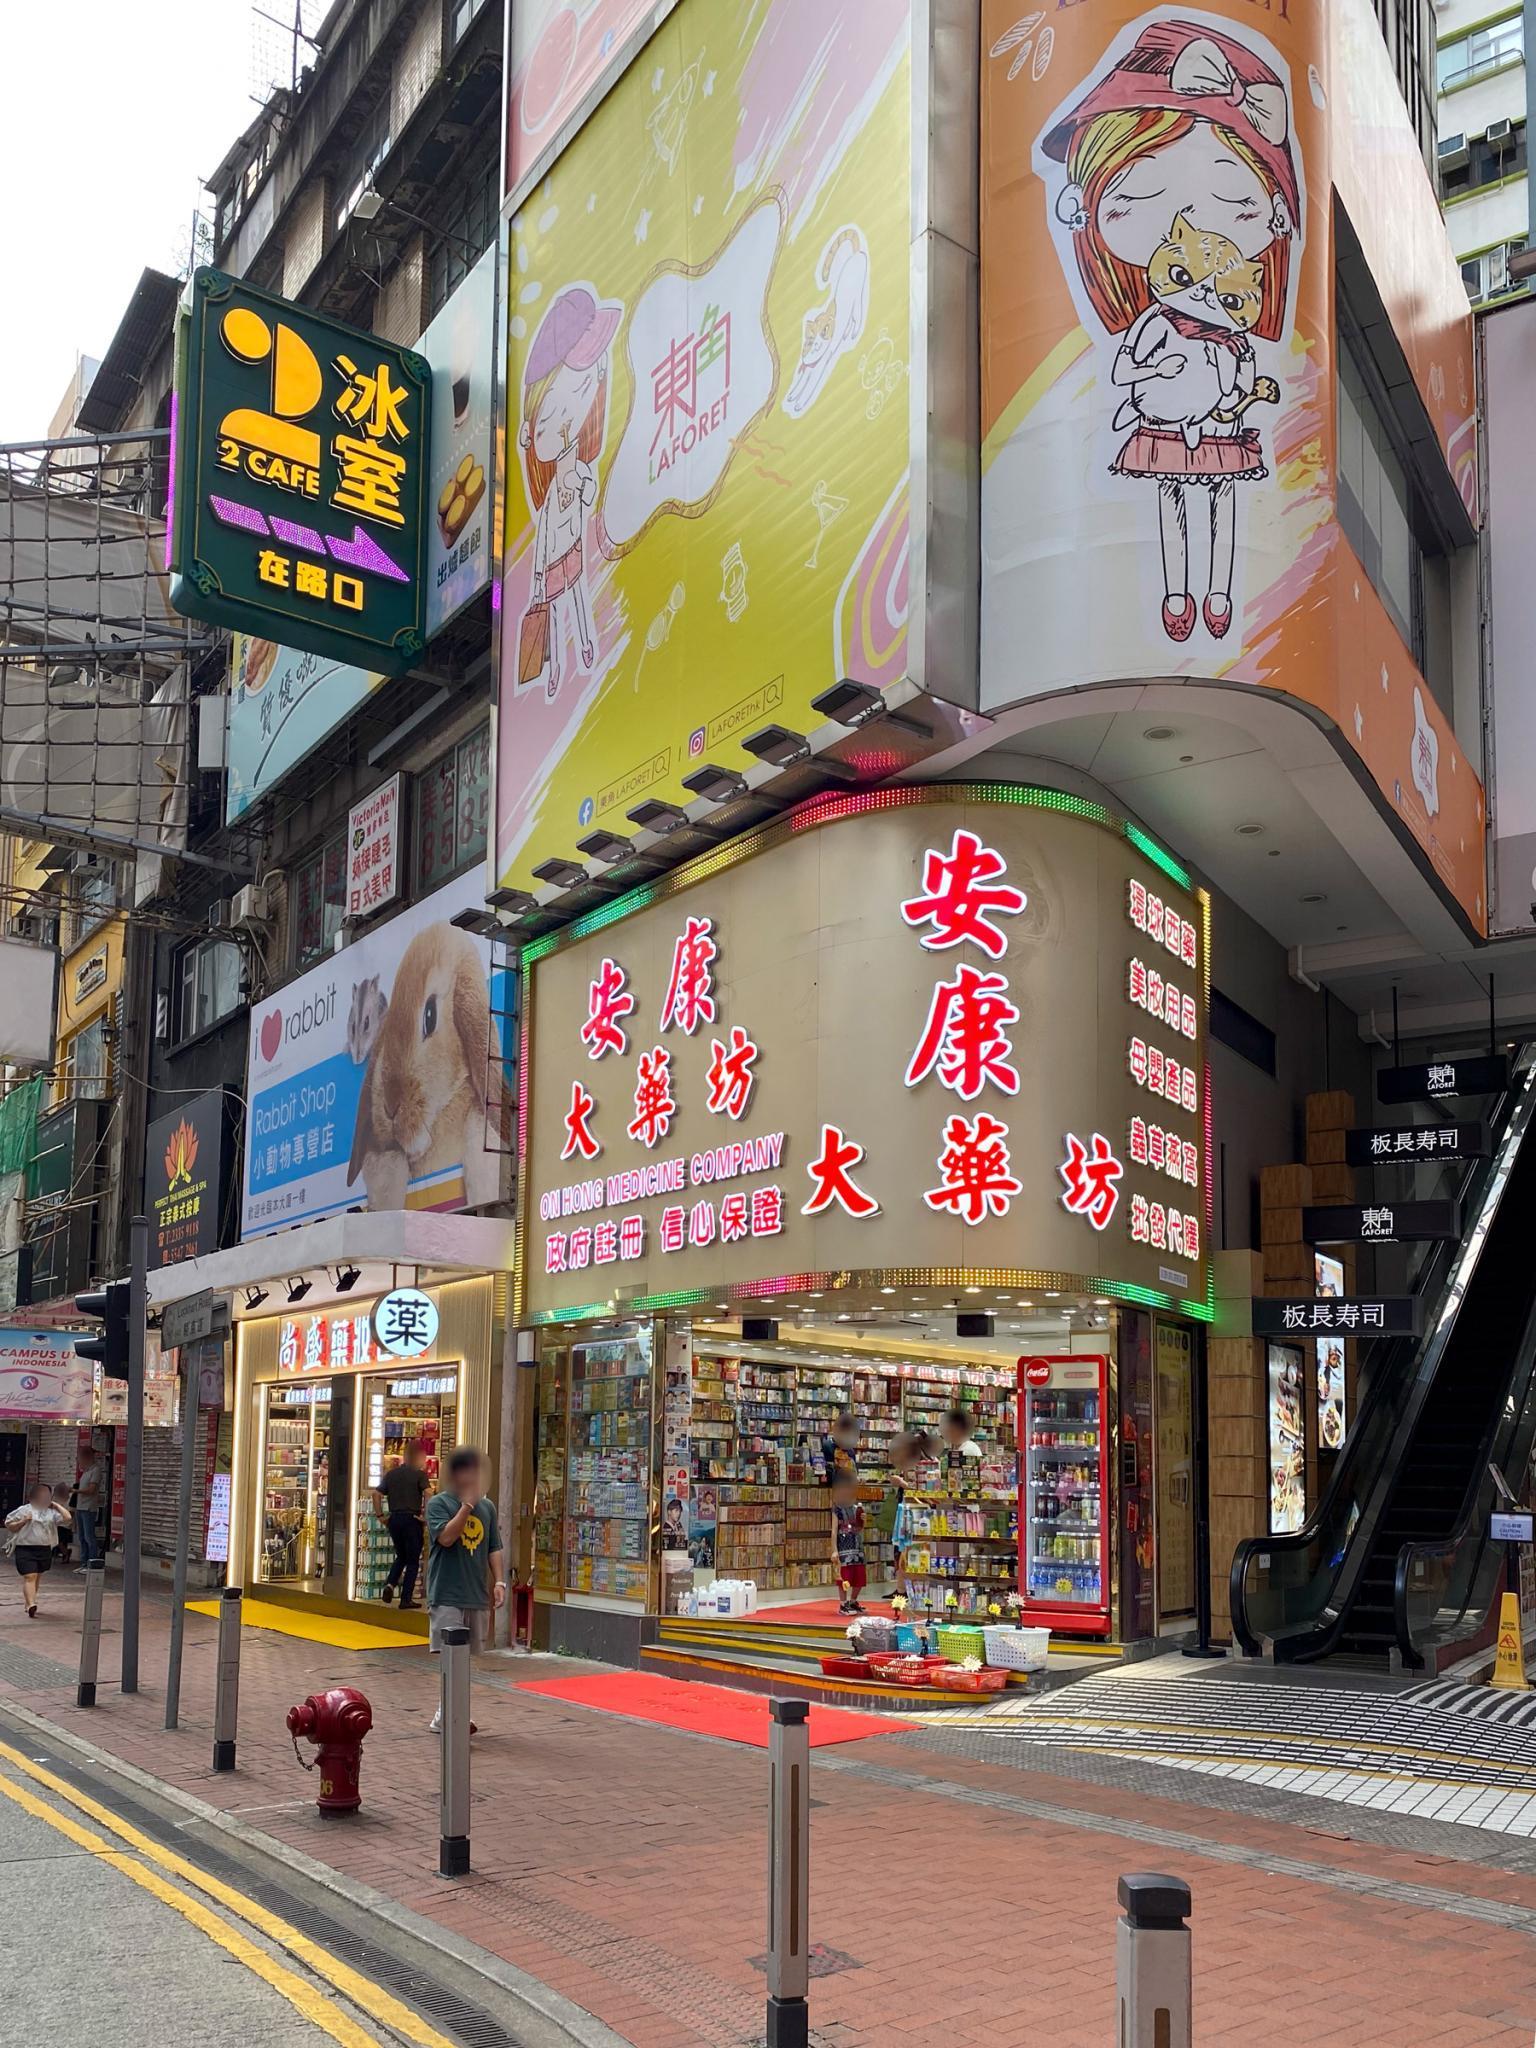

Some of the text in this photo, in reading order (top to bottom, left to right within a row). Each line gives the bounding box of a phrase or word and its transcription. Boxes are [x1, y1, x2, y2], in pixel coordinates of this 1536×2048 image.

[218, 440, 320, 498] 2 CAFE
[649, 391, 730, 484] LAFORET
[258, 549, 364, 611] 在路口
[352, 799, 380, 827] Victoria
[1129, 878, 1197, 969] 環球西藥
[581, 916, 717, 1061] 安康
[900, 828, 1028, 1102] 安康
[284, 981, 337, 1045] rabbit
[560, 1025, 758, 1161] 大藥坊
[1129, 1036, 1197, 1113] 母嬰產品
[1427, 1081, 1455, 1090] LAFORET
[255, 1081, 336, 1137] Rabbit Shop
[254, 1122, 335, 1181] 小動物專營店
[801, 1111, 1124, 1231] 大藥坊
[1130, 1116, 1198, 1187] 蟲草燕窩
[1370, 1128, 1459, 1155] 板長寿司
[540, 1132, 784, 1221] ON HONG MEDICINE COMPANY
[545, 1185, 784, 1274] 政府註冊 信心保證
[1131, 1193, 1200, 1261] 批發代購
[1361, 1228, 1393, 1236] LAFORET
[1282, 1303, 1385, 1329] 板長寿司
[1, 1348, 57, 1359] CAMPUS
[12, 1360, 68, 1368] INDONESIA
